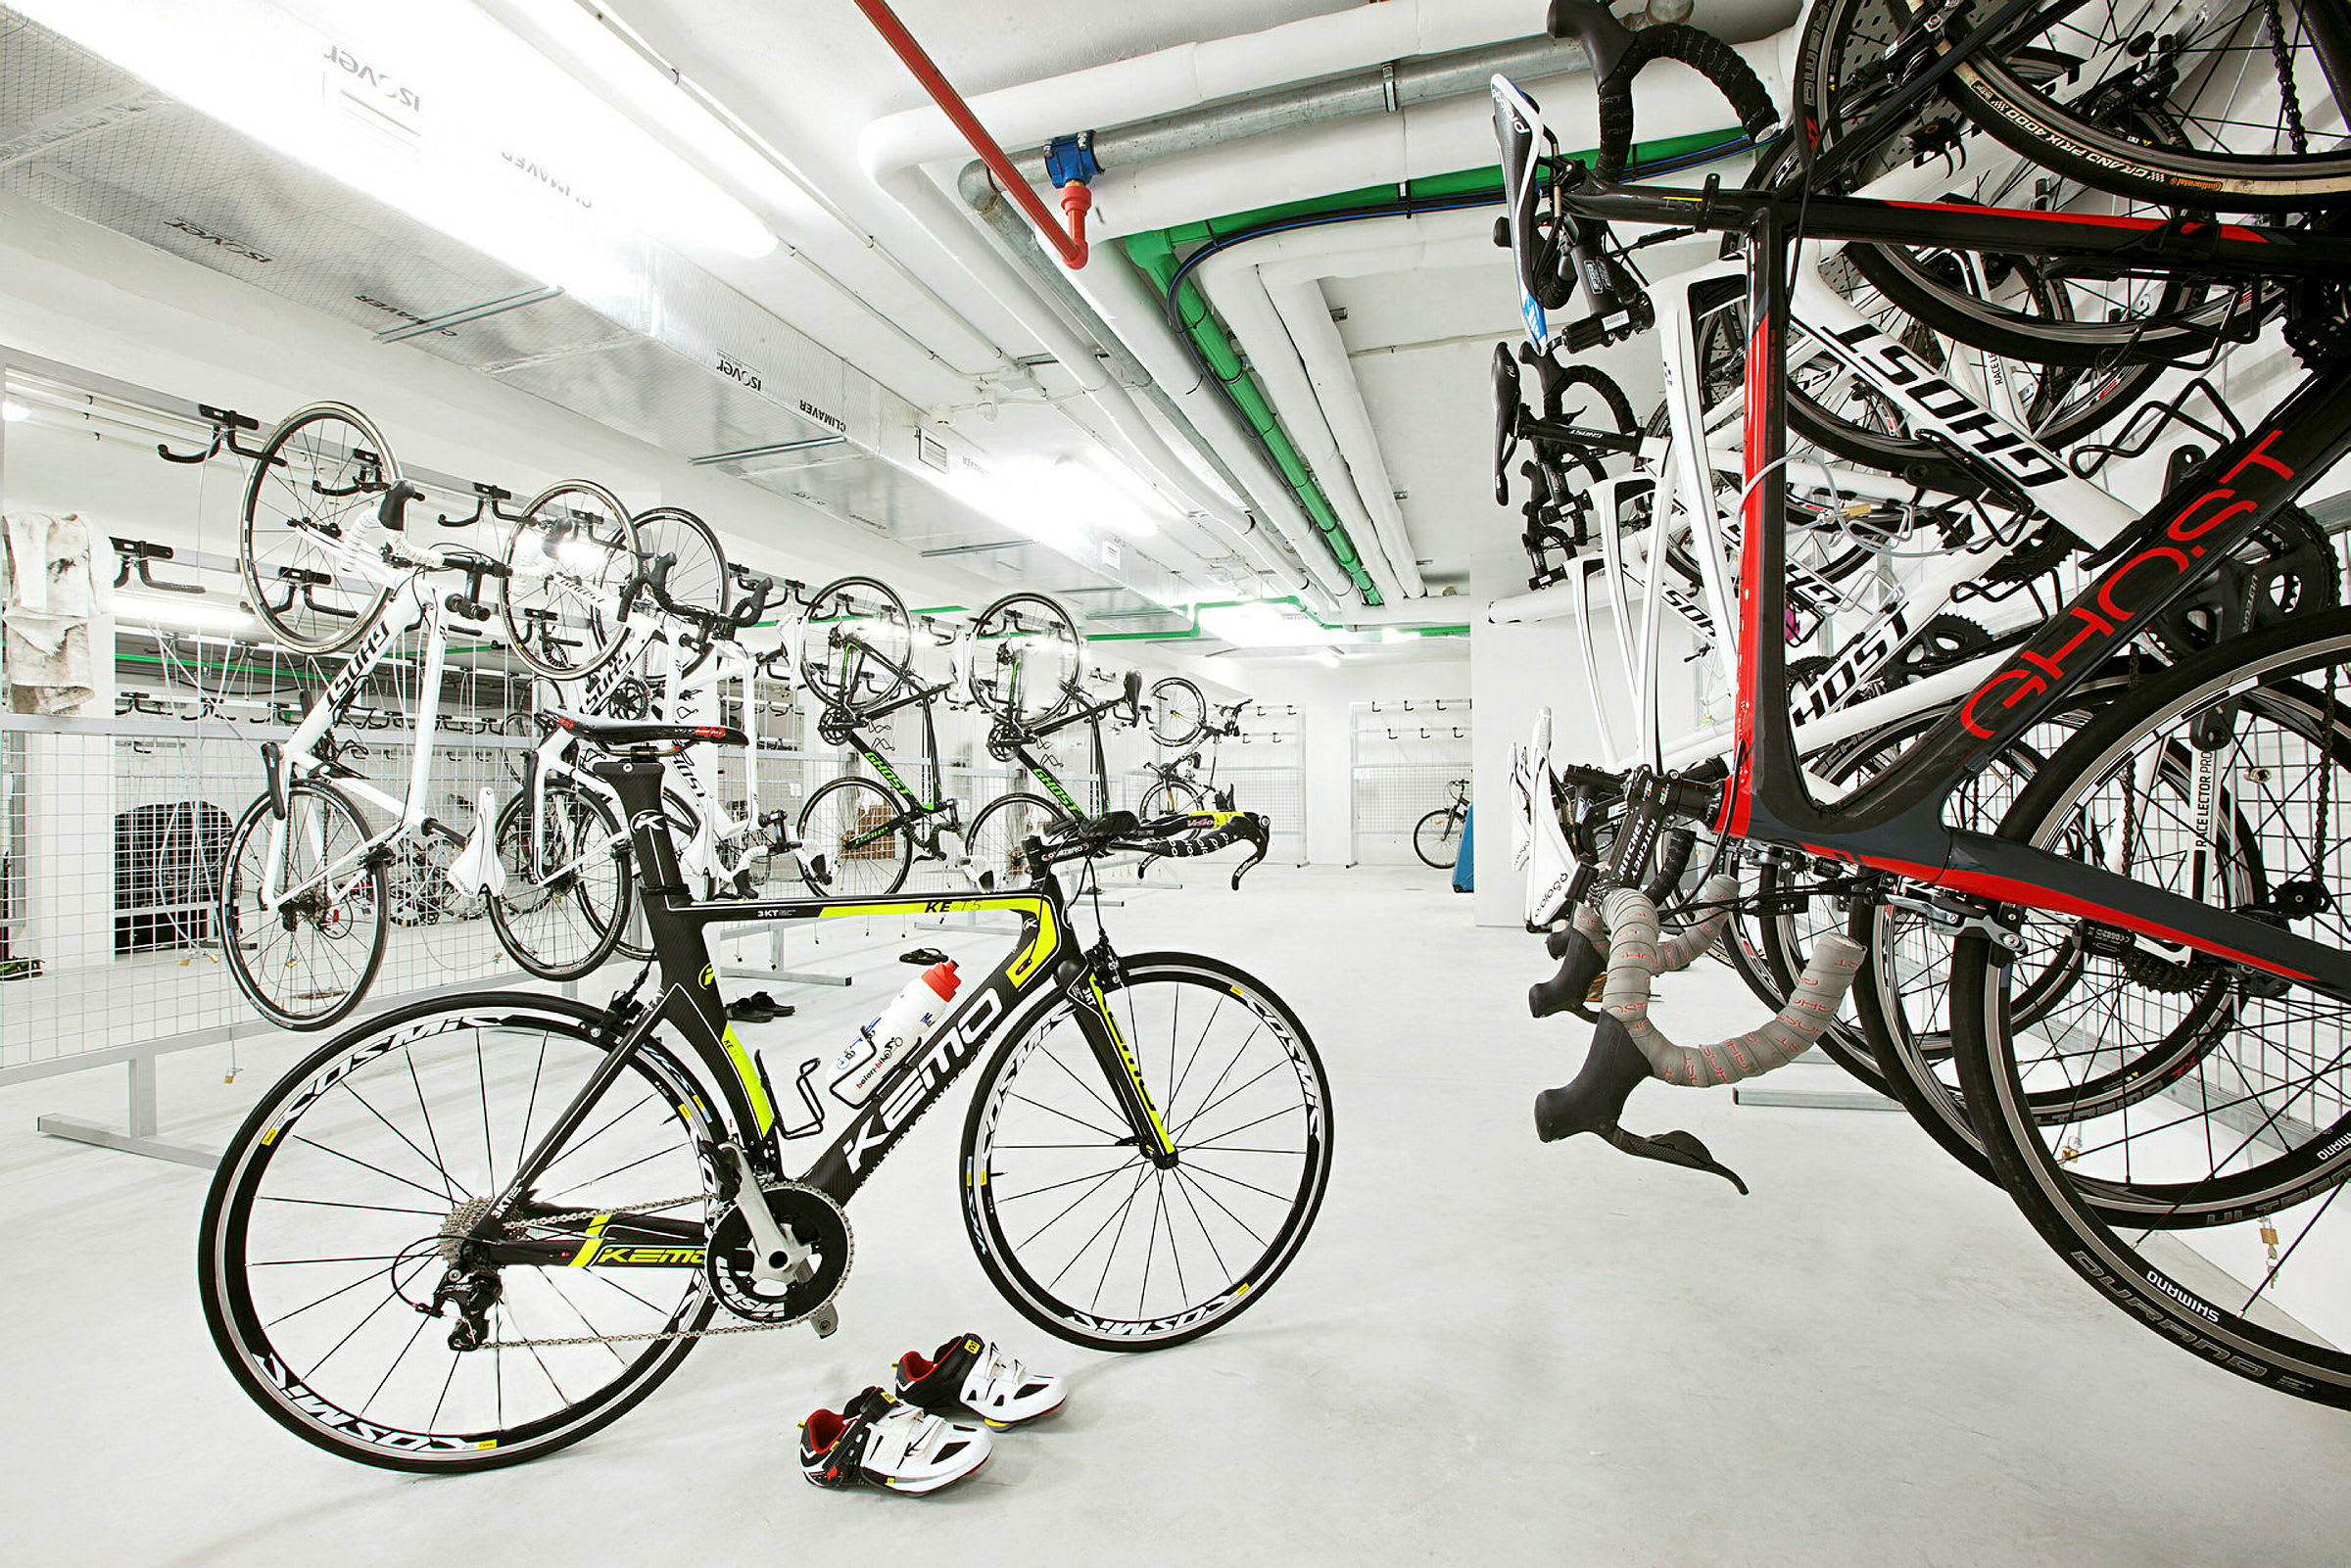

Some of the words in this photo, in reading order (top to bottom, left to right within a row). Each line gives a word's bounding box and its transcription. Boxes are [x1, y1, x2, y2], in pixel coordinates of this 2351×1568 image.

[2005, 109, 2047, 137] 4000
[2045, 133, 2088, 158] PRIX
[2086, 152, 2151, 178] GRAND
[799, 399, 846, 433] CLIMAVER
[1820, 323, 2069, 488] GHOST
[327, 620, 389, 712] GHOST
[865, 751, 912, 796] GHOST
[1032, 768, 1081, 812] GHOST
[2197, 775, 2210, 815] LECTOR
[1618, 814, 1645, 877] RITCHEY
[1631, 819, 1657, 879] RITCHEY
[2194, 815, 2207, 847] RACE
[846, 987, 1003, 1173] KEMO
[2070, 1250, 2268, 1377] DURANO
[2145, 1269, 2221, 1323] SHIMANO
